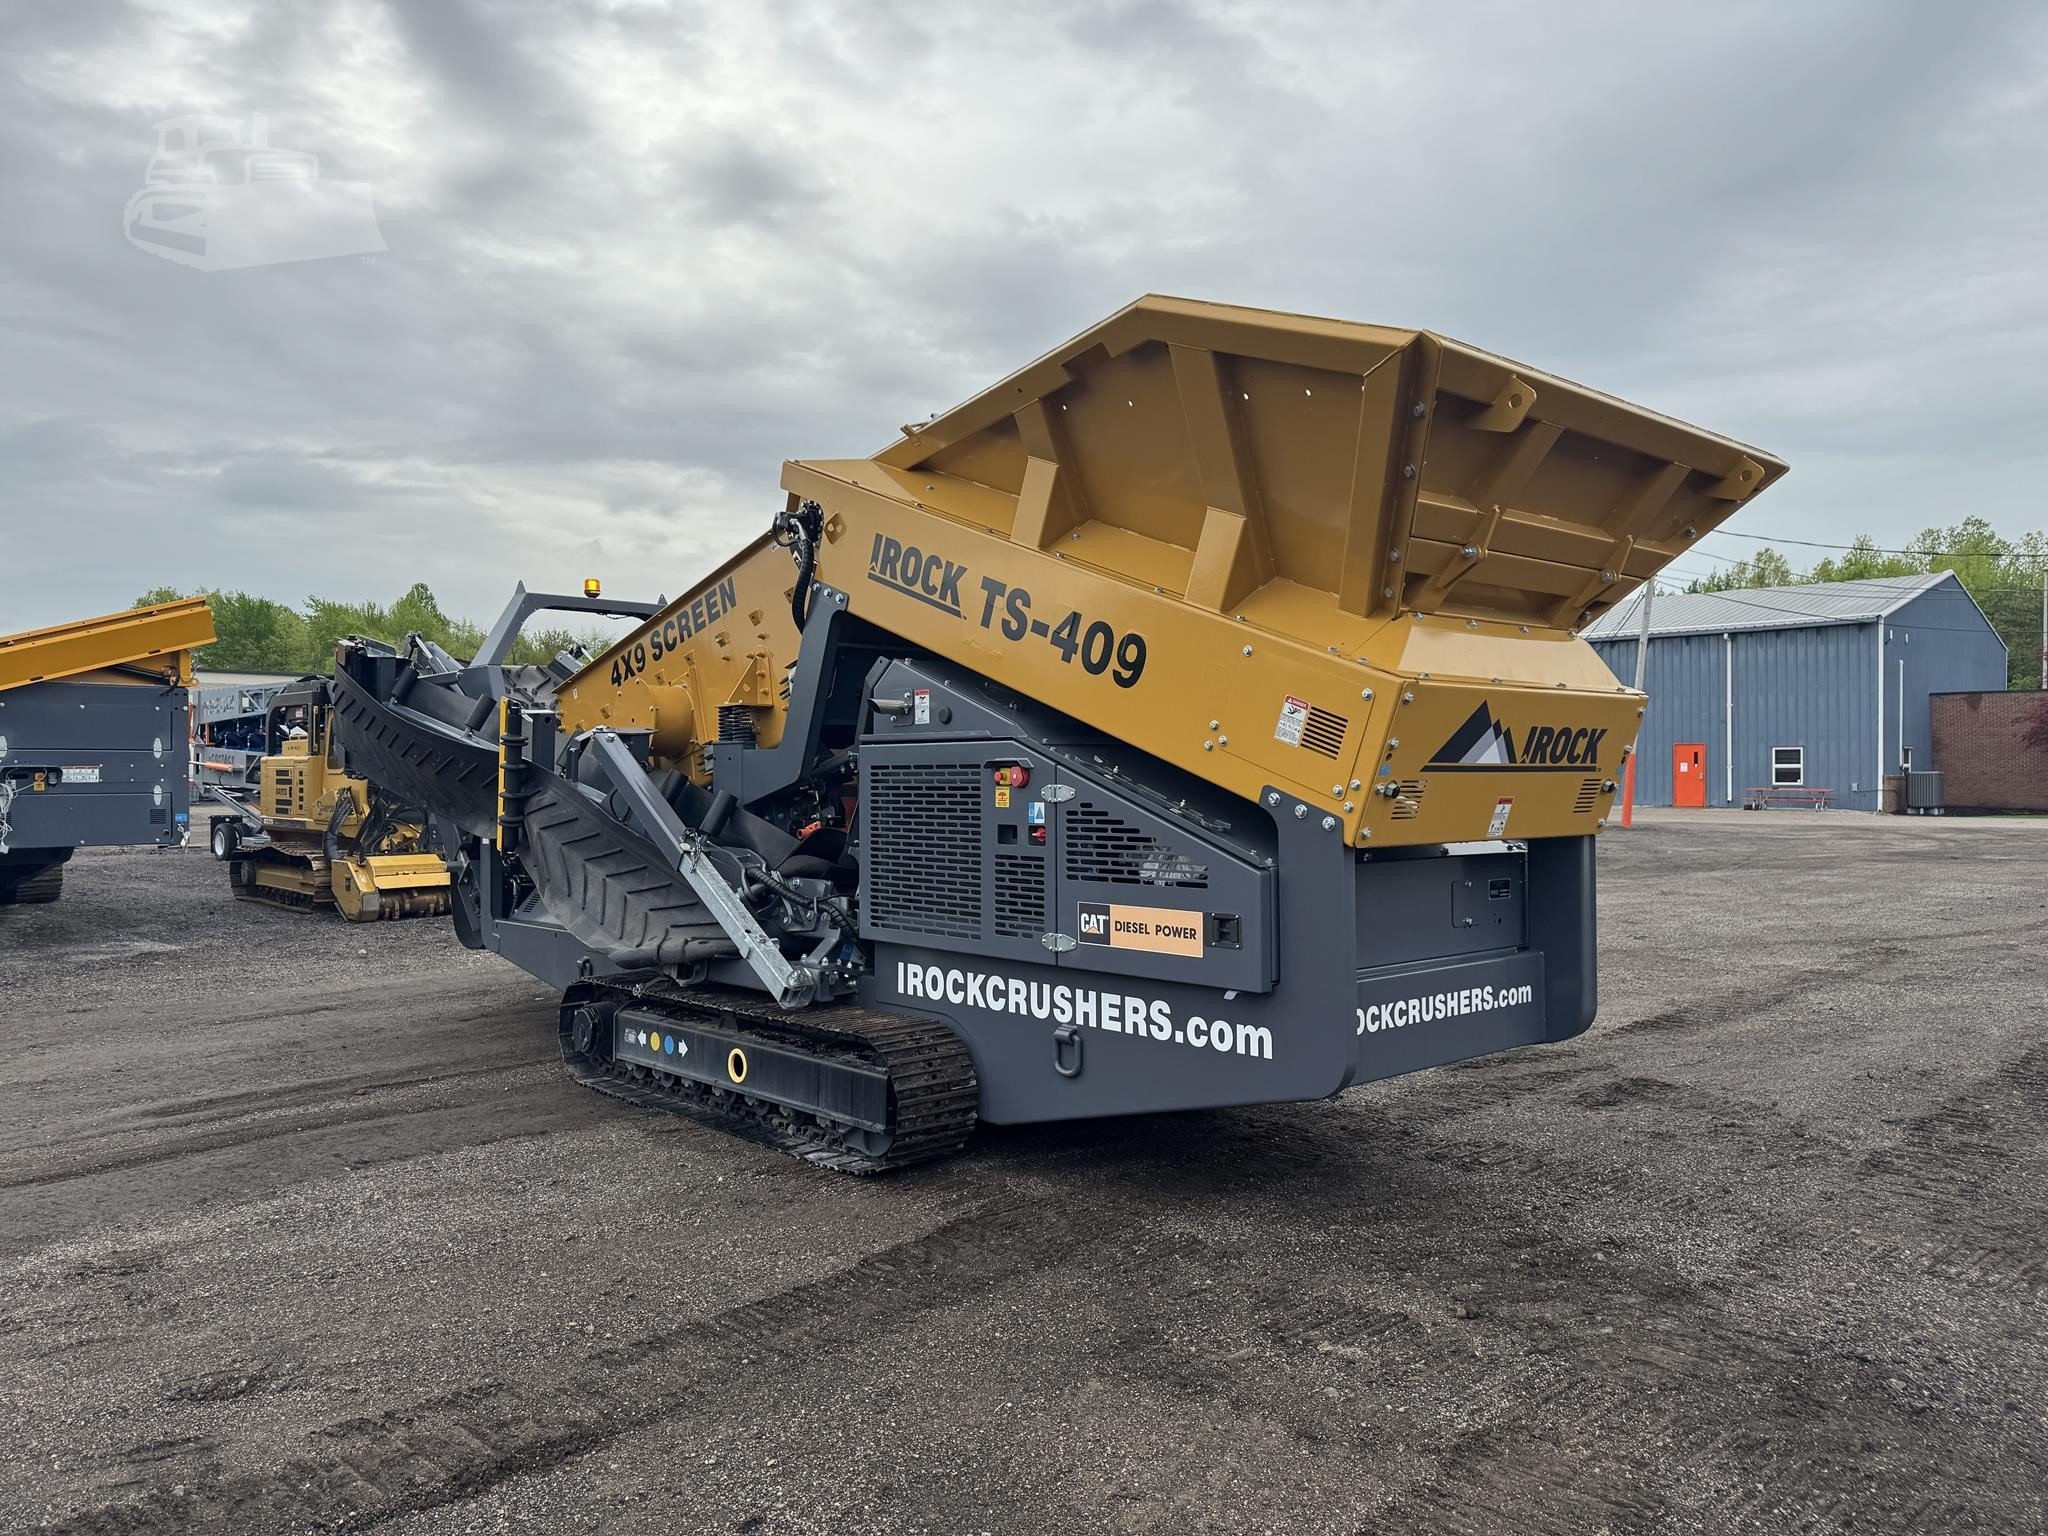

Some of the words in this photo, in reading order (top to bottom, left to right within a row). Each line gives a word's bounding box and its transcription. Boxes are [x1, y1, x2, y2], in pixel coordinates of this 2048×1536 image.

[611, 643, 646, 687] 4X9
[650, 576, 737, 662] SCREEN
[869, 532, 968, 608] IROCK
[980, 575, 1147, 689] TS-409
[1520, 726, 1608, 764] IROCK
[1080, 912, 1109, 934] CAT
[1114, 920, 1150, 935] DIESEL
[1155, 924, 1197, 940] POWER
[897, 961, 1273, 1060] IROCKCRUSHERS.com
